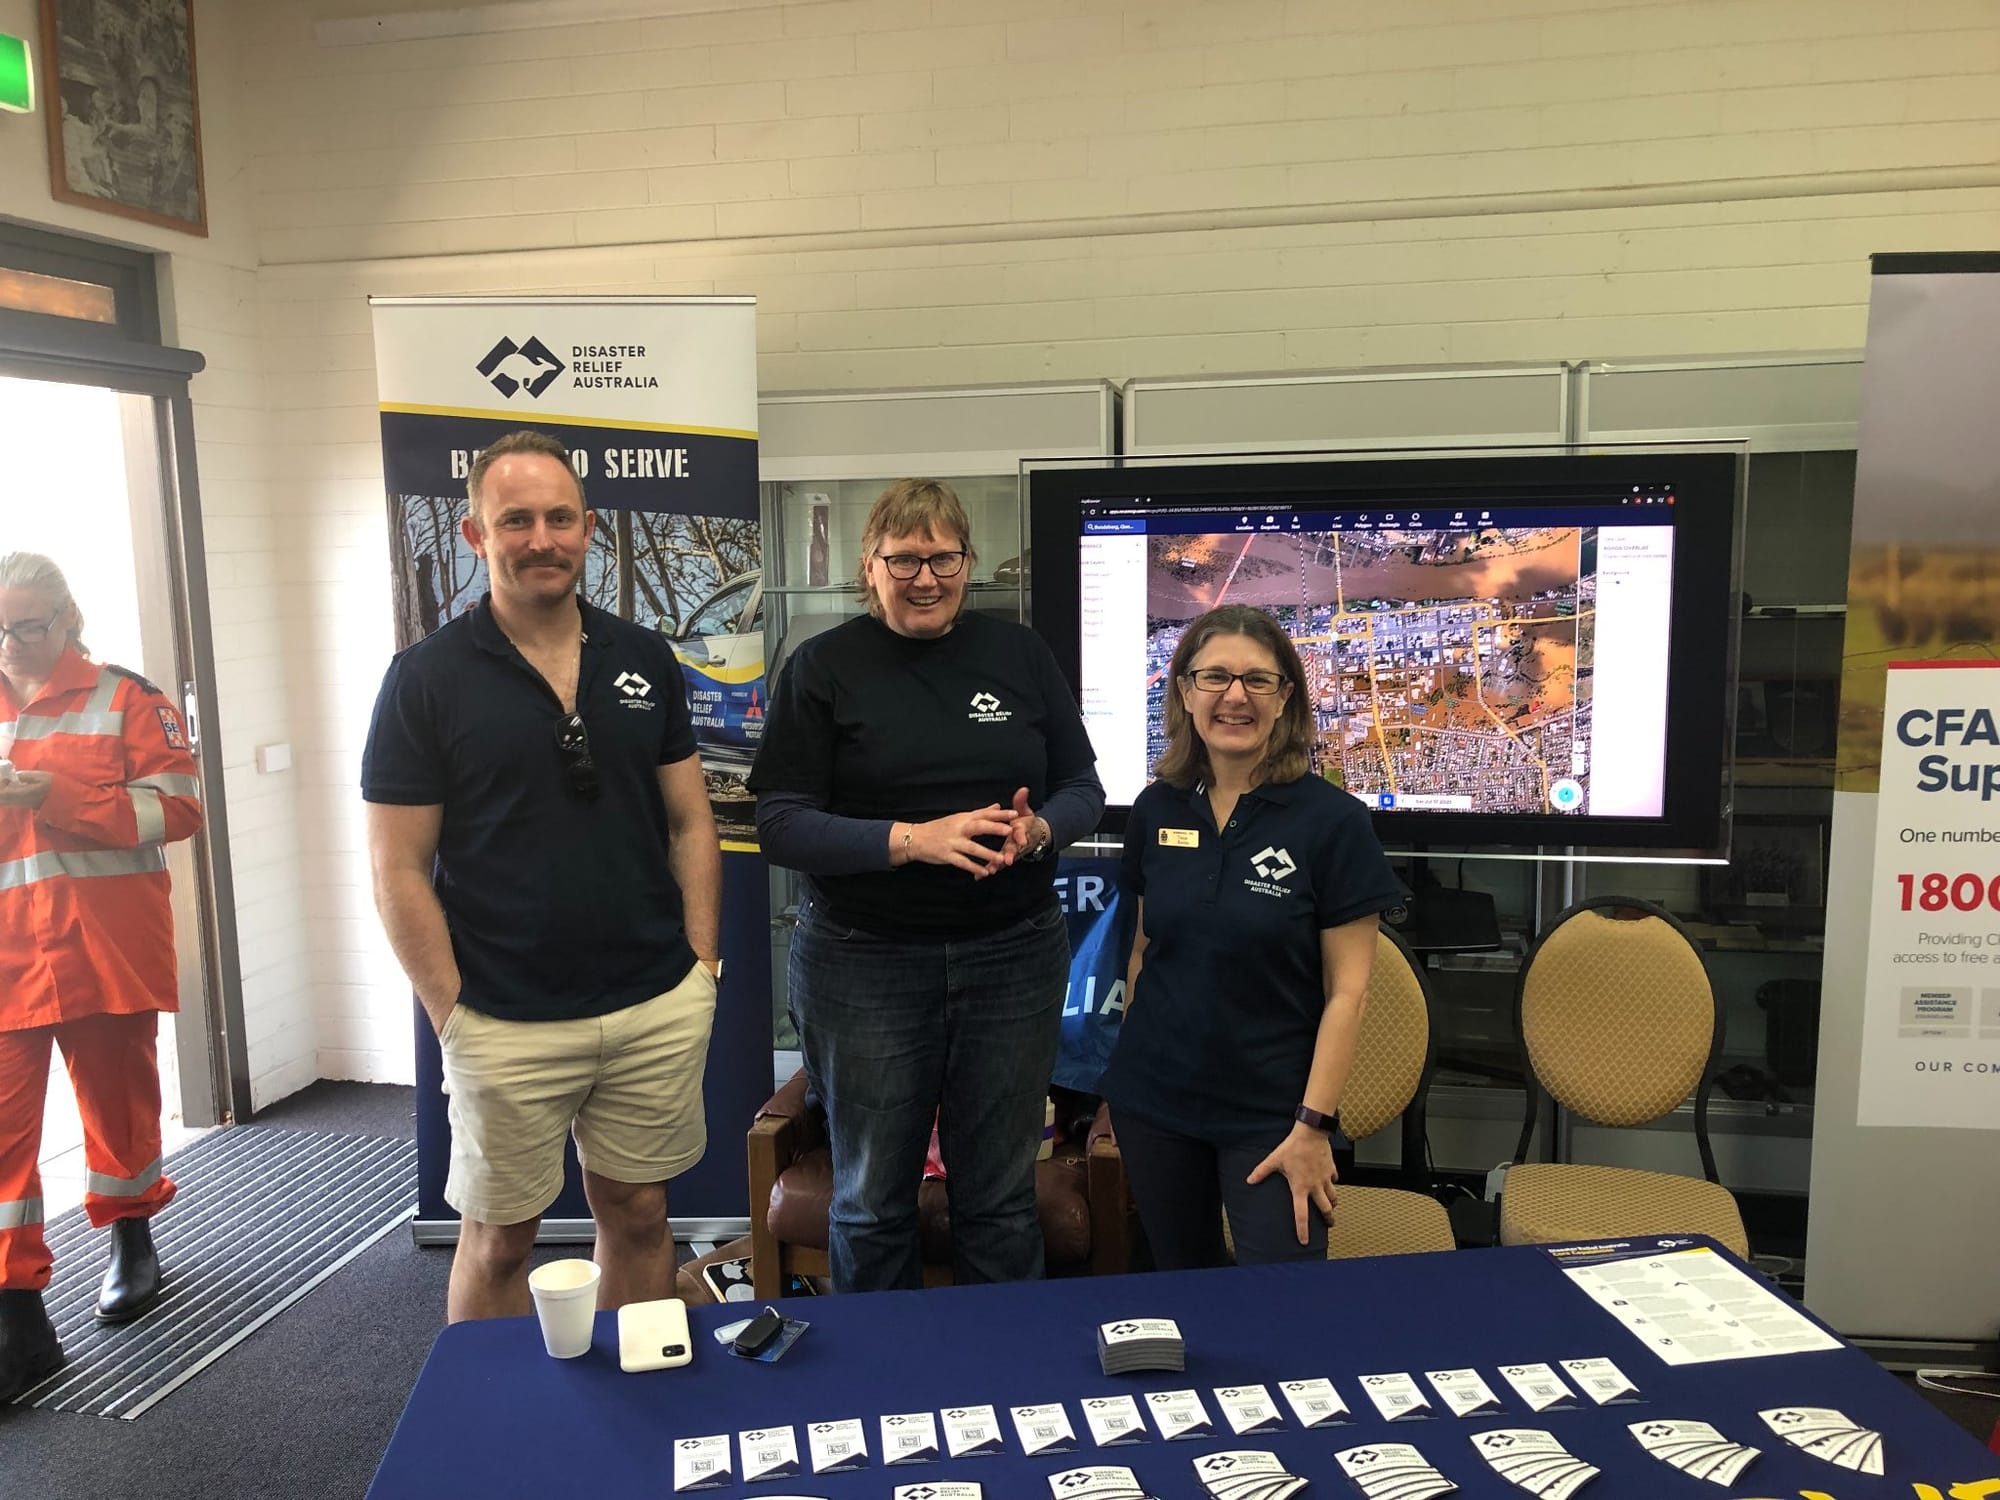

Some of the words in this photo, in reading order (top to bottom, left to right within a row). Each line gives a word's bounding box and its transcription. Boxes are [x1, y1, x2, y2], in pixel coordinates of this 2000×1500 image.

[572, 346, 646, 357] DISASTER
[573, 362, 622, 372] RELIEF
[573, 377, 658, 388] AUSTRALIA
[565, 449, 588, 479] O
[604, 448, 689, 479] SERVE
[693, 690, 722, 702] DISASTER
[692, 703, 712, 714] RELIEF
[691, 716, 725, 728] AUSTRALIA
[1897, 709, 2000, 747] CFA
[1916, 754, 2000, 801] Sup
[1900, 828, 1936, 843] One
[1942, 828, 2000, 843] numbe
[1918, 932, 1982, 948] Providing
[1893, 954, 1939, 963] access
[1944, 952, 1956, 963] to
[1961, 951, 1988, 963] free
[1915, 1062, 1952, 1072] OUR
